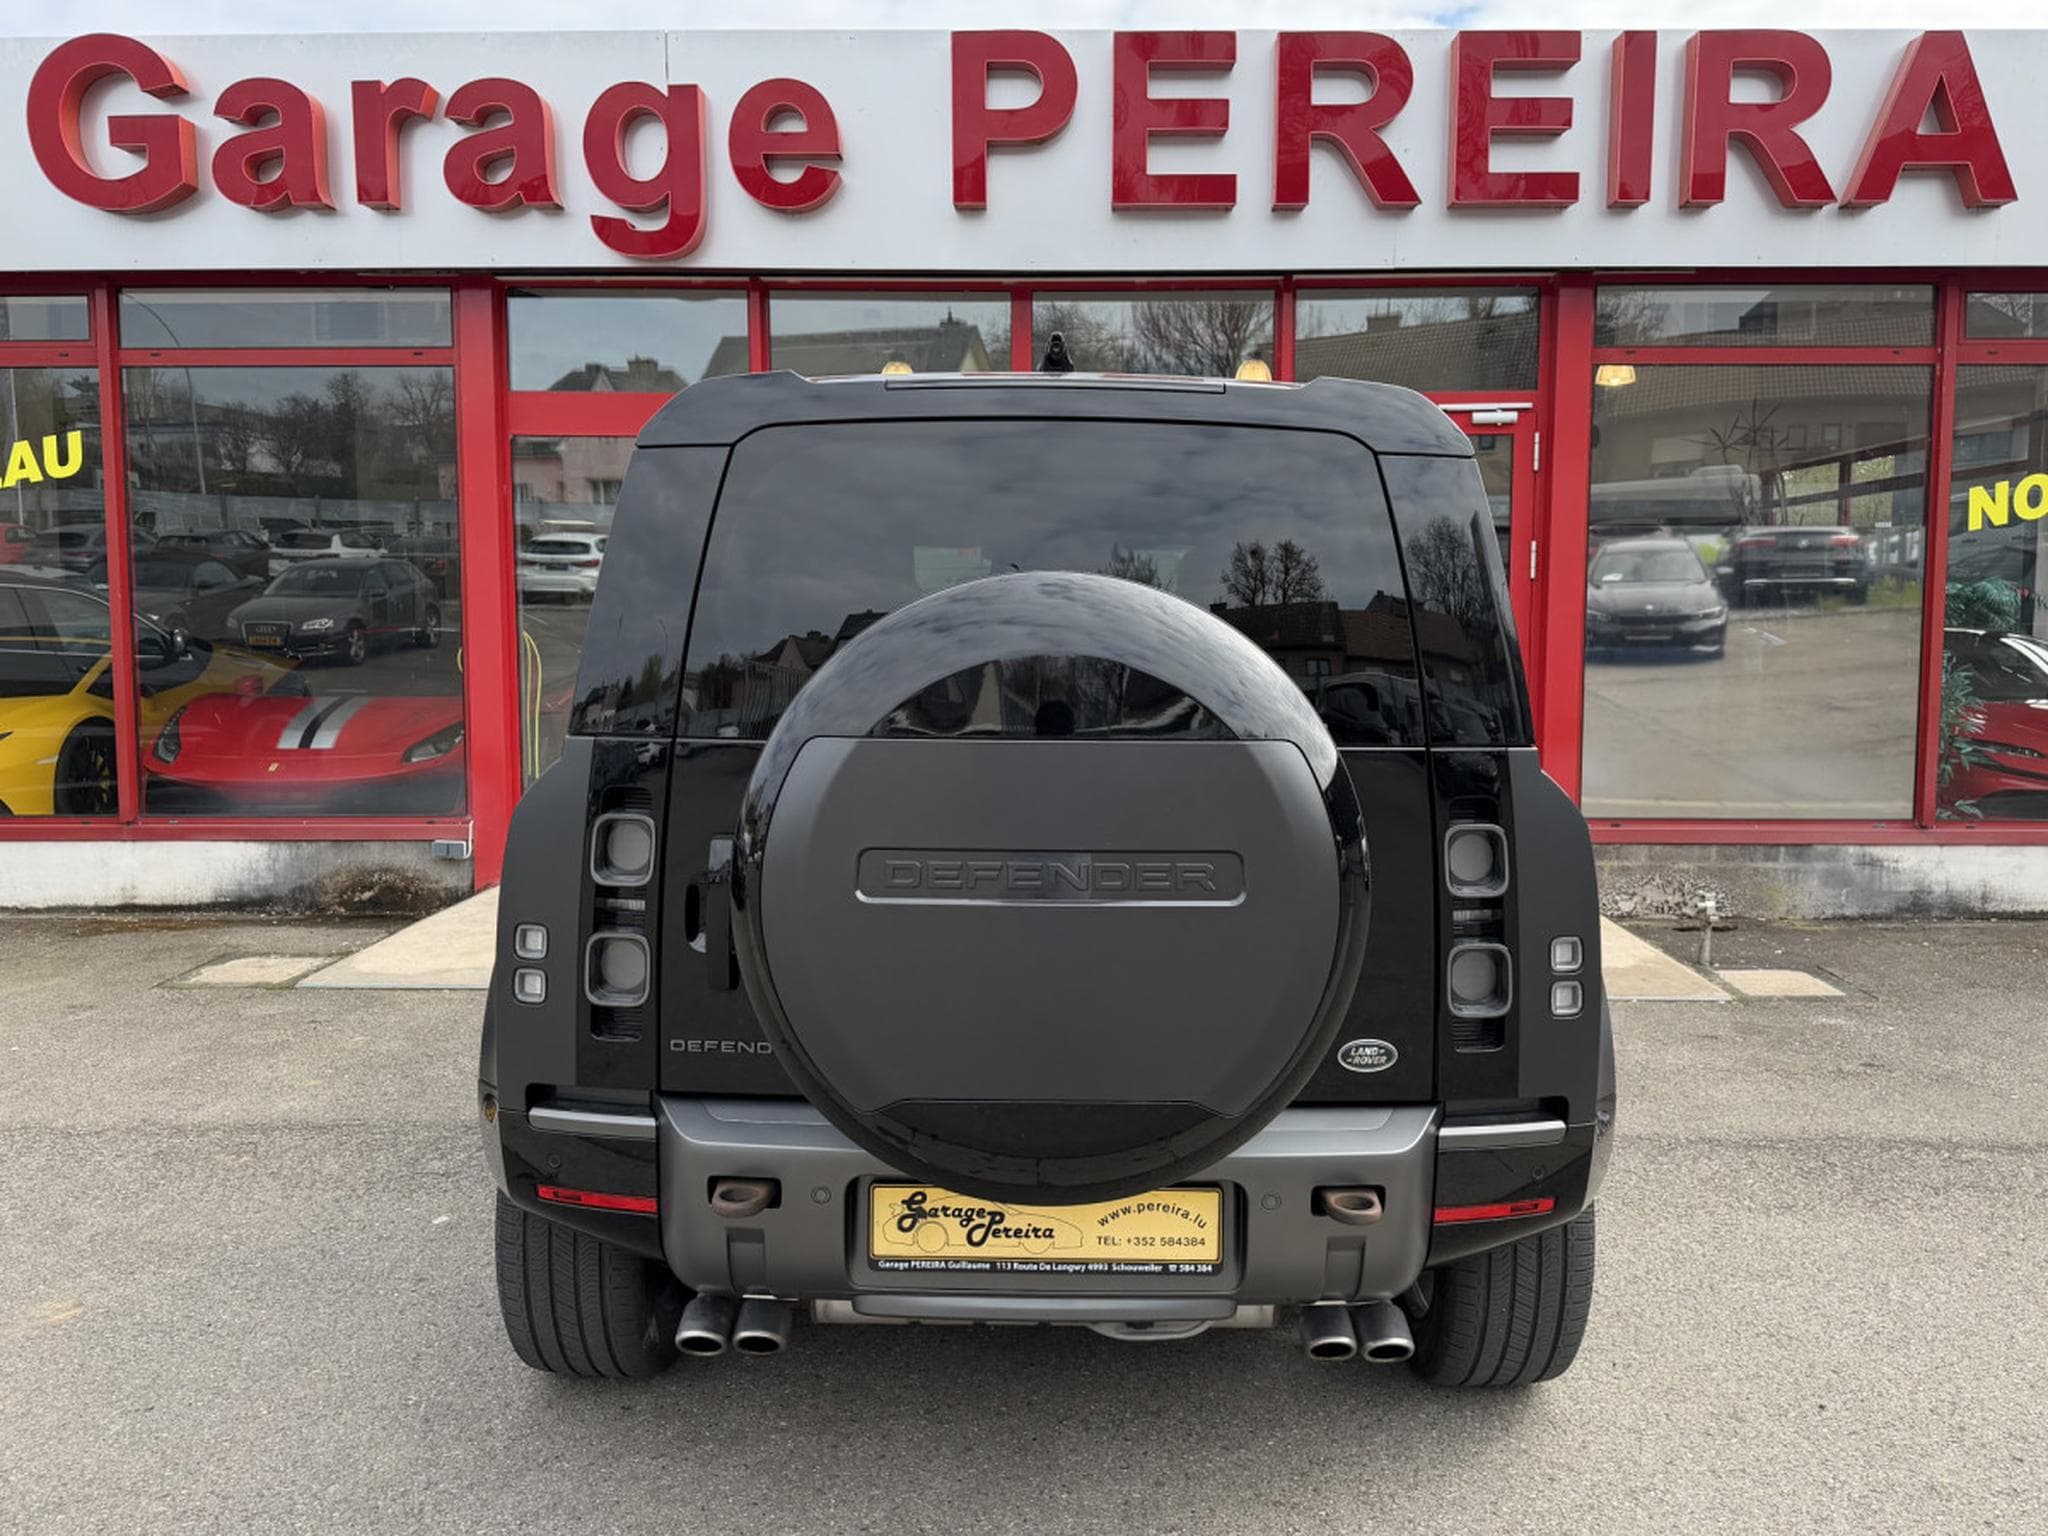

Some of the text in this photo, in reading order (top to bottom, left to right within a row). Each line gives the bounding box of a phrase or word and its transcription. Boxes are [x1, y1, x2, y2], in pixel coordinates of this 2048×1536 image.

[27, 30, 2018, 262] Garage PEREIRA
[0, 430, 83, 489] AU
[1968, 473, 2048, 532] NO
[884, 859, 1218, 892] DEFENDER
[897, 1191, 986, 1233] Garage
[966, 1211, 1055, 1247] Pereira
[1096, 1201, 1207, 1230] www.pereira.lu
[1096, 1236, 1206, 1247] TEL: +352 584384
[878, 1260, 909, 1270] Garage
[910, 1260, 946, 1270] PEREIRA
[947, 1260, 991, 1270] Guillaume
[996, 1261, 1012, 1271] 113
[1013, 1261, 1038, 1271] Route
